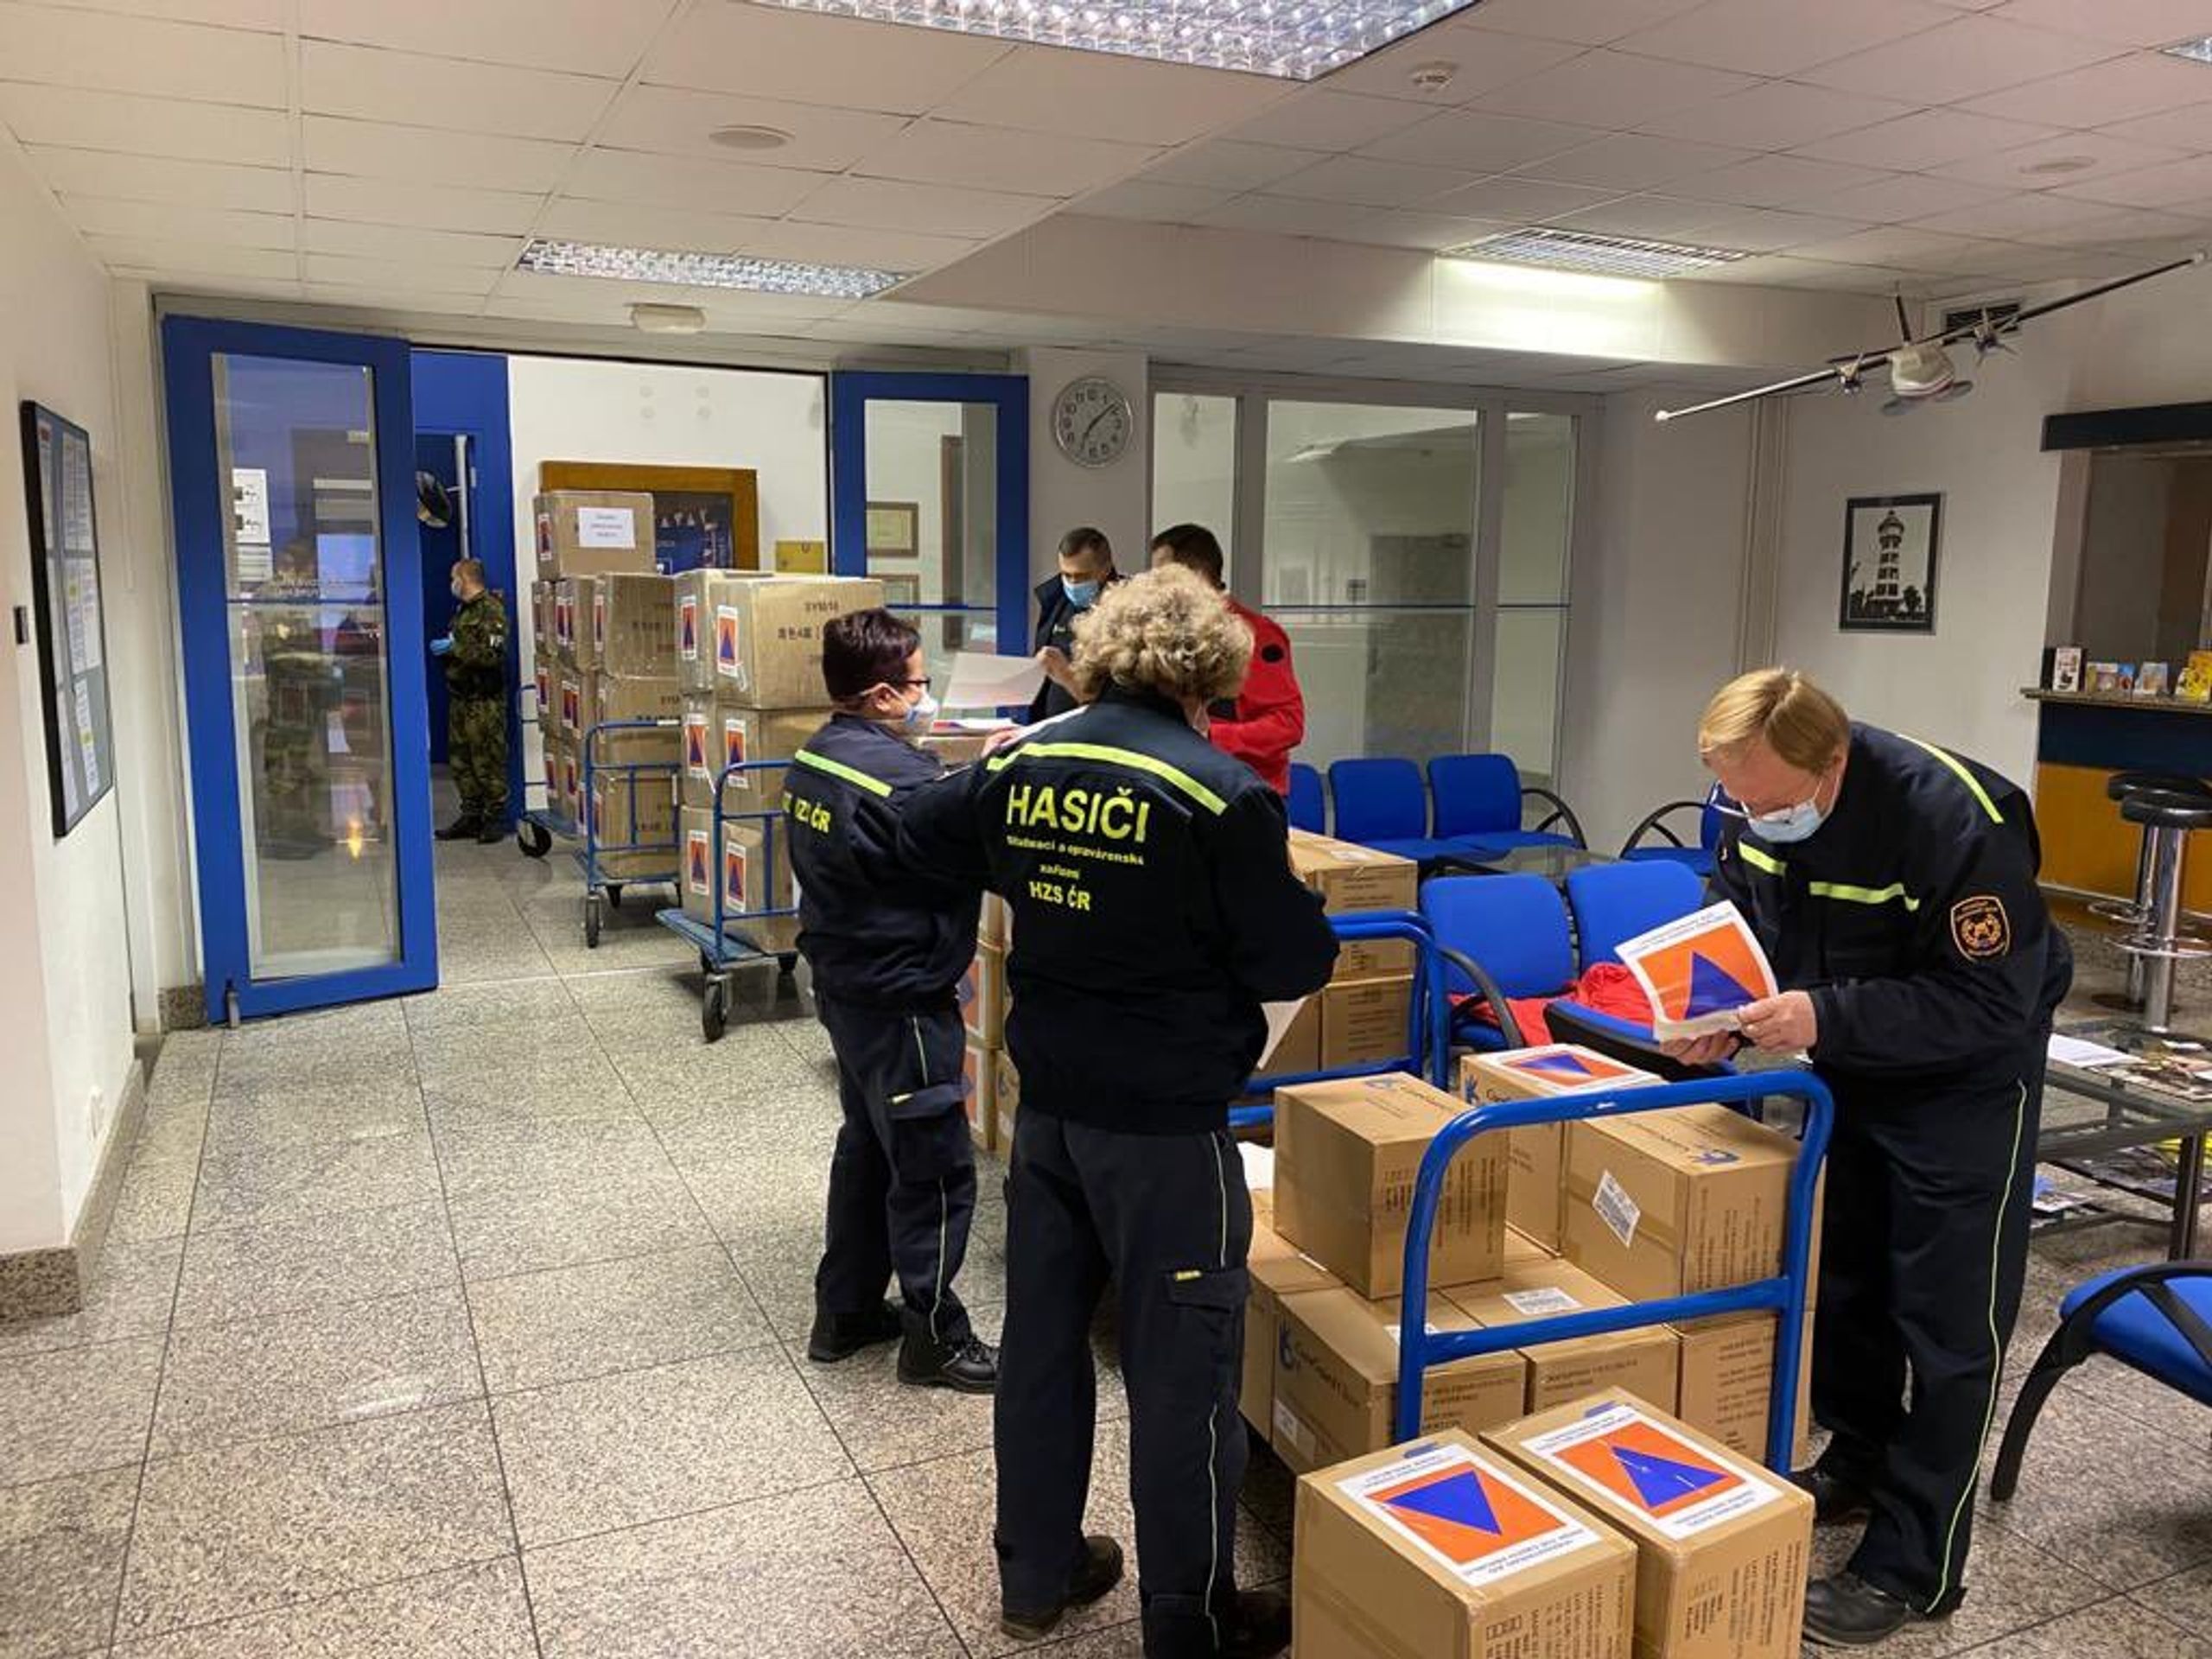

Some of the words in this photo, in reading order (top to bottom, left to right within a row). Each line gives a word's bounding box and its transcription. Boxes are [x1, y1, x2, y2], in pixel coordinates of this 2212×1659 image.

[1007, 784, 1150, 842] HASIČI
[1029, 881, 1064, 905] HZS
[1067, 884, 1090, 911] ČR
